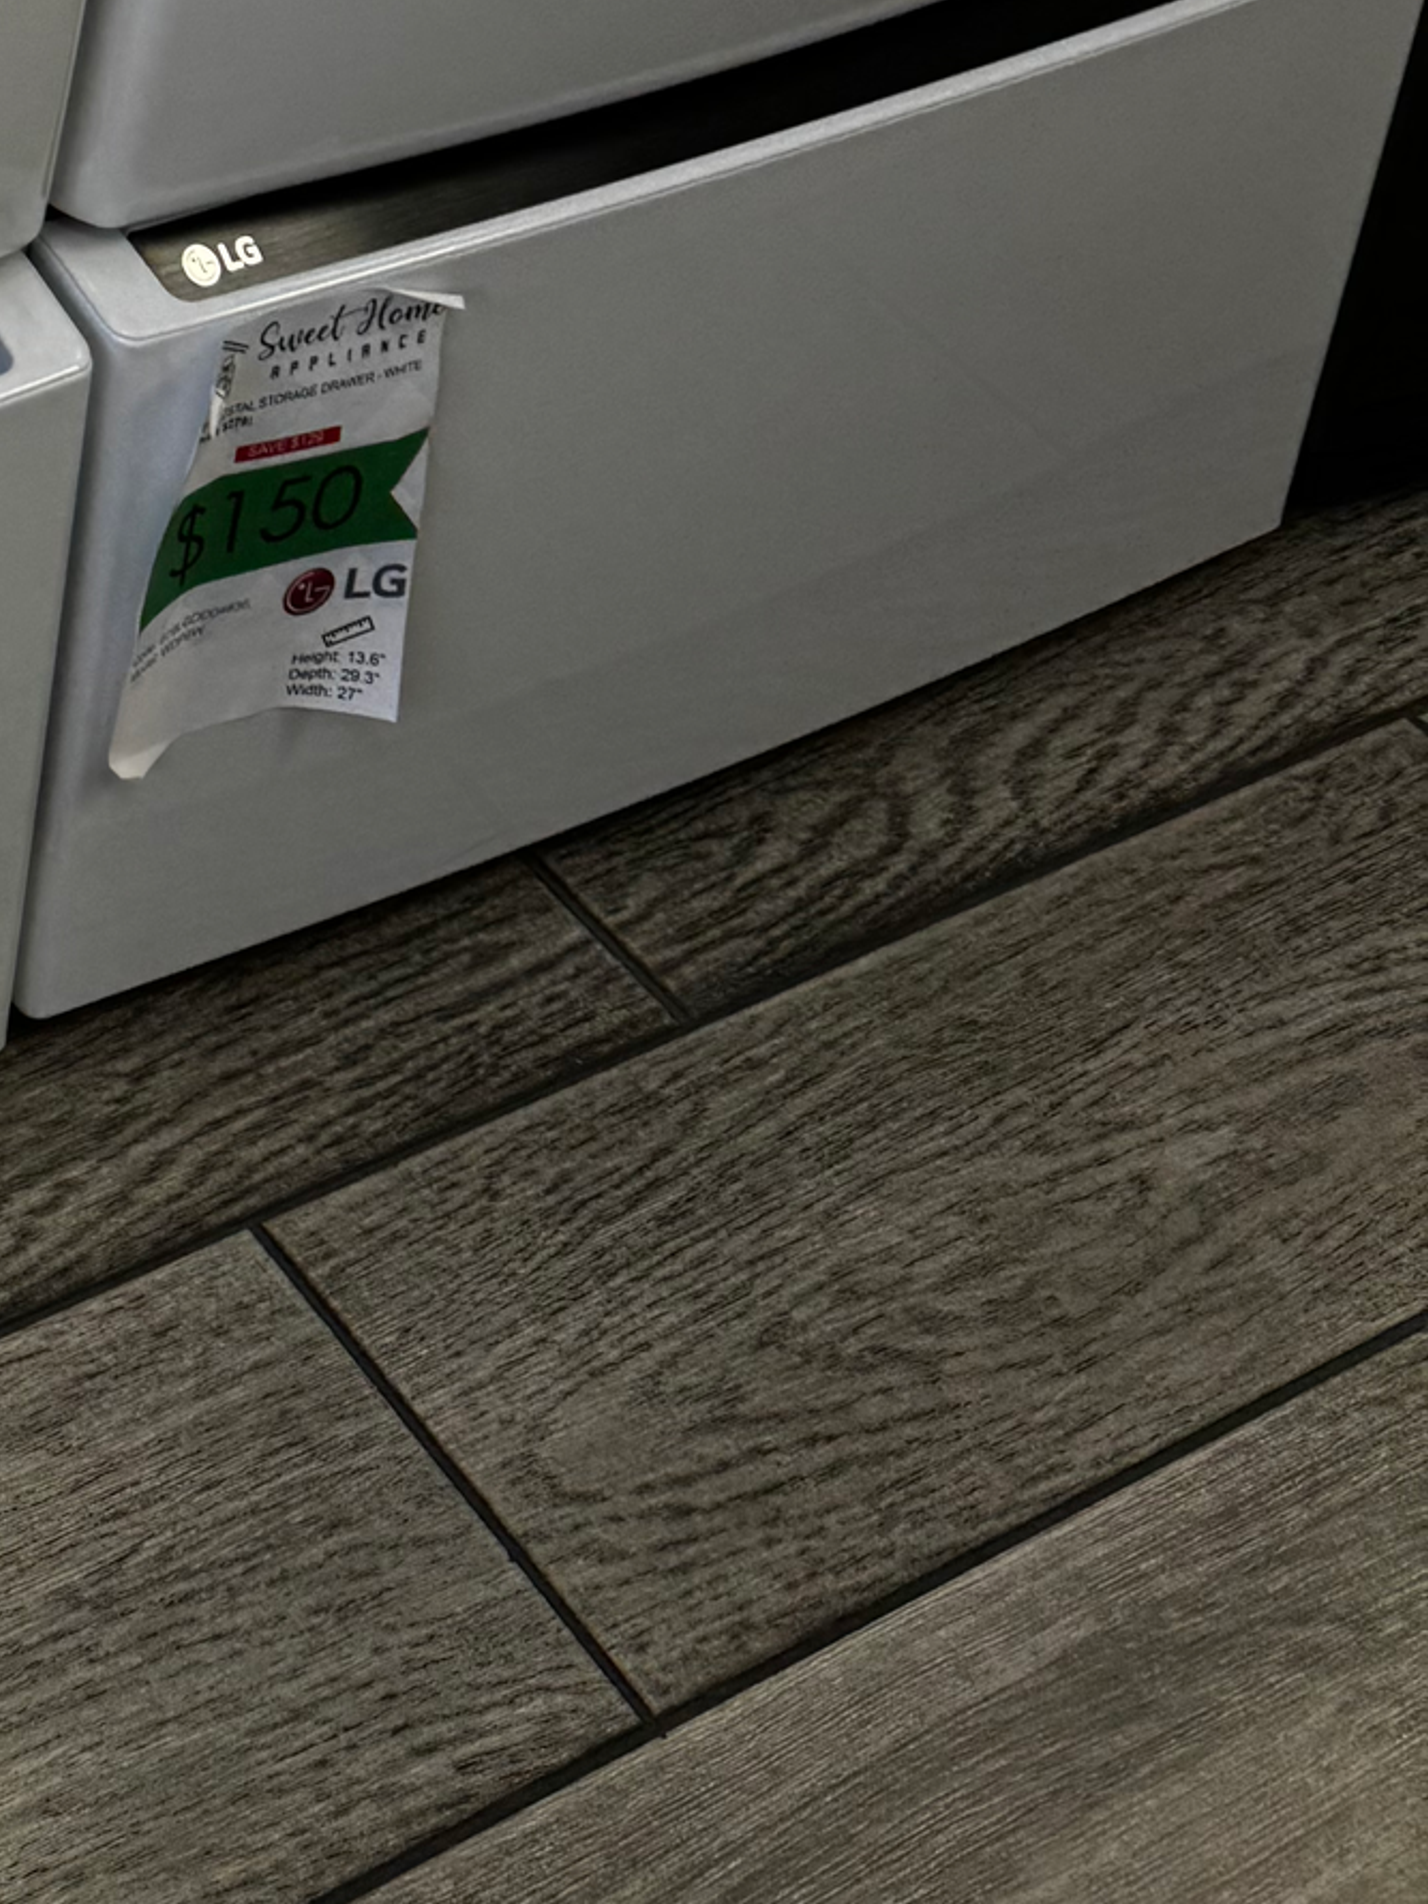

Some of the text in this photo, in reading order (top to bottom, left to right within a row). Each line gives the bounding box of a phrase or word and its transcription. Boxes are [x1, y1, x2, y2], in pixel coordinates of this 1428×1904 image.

[216, 235, 264, 274] LG
[257, 303, 347, 362] Sweet
[269, 328, 429, 380] APPLIANCE
[258, 358, 424, 410] STORAGE DRAWER WHITE
[168, 463, 363, 586] $150
[343, 563, 409, 600] LG
[285, 683, 333, 698] Width:
[287, 667, 336, 683] Depth:
